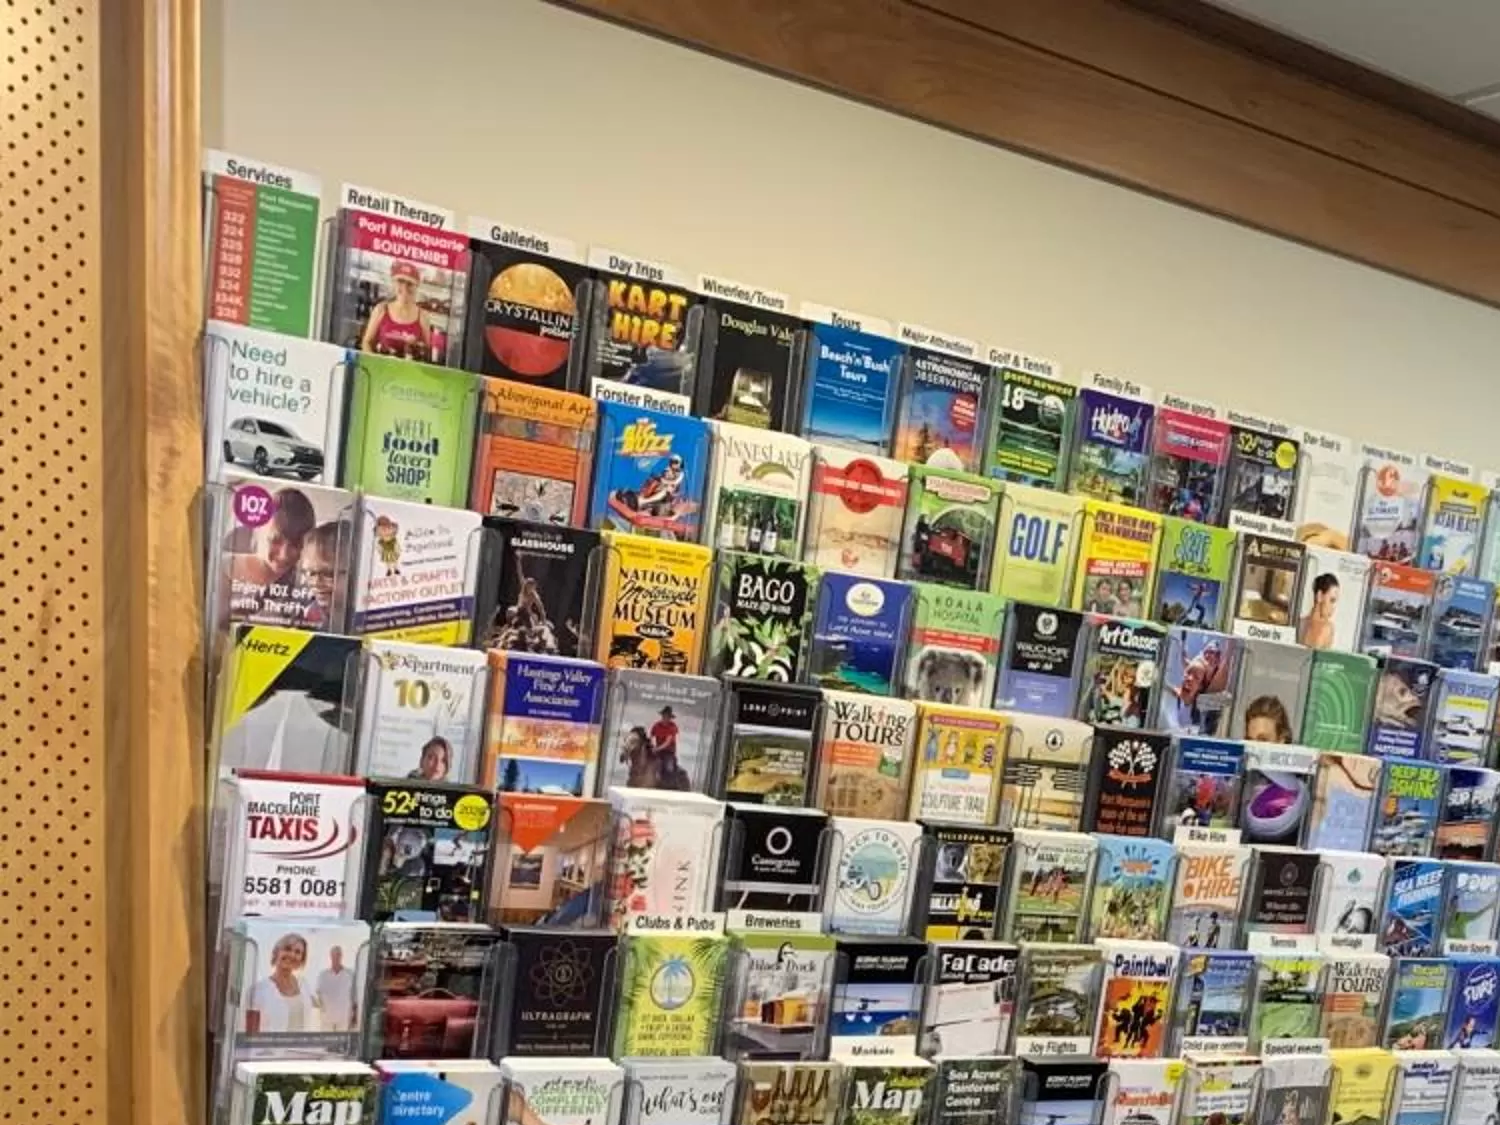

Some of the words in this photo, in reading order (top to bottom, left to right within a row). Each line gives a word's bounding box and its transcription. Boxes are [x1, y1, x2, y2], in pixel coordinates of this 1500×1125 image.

[226, 159, 293, 190] Services
[347, 189, 390, 212] Retail
[393, 201, 446, 229] Therapy
[359, 217, 385, 234] Port
[390, 225, 465, 251] Macquarie
[491, 226, 550, 253] Galleries
[372, 238, 449, 266] SOUVENIRS
[609, 256, 631, 273] Day
[634, 261, 664, 281] Trips
[608, 279, 688, 318] KART
[702, 278, 785, 310] Wineries/Tours
[611, 309, 678, 349] HIRE
[721, 313, 768, 338] Douglas
[831, 312, 862, 330] Tours
[902, 327, 927, 343] Major
[231, 340, 286, 364] Need
[990, 349, 1012, 363] Golf
[1013, 354, 1021, 366] &
[1023, 358, 1053, 374] Tennis
[229, 364, 249, 379] to
[255, 367, 293, 389] hire
[300, 377, 311, 391] a
[841, 366, 868, 384] Tours
[1093, 373, 1123, 391] Family
[1124, 381, 1141, 394] Fun
[228, 387, 311, 412] vehicle?
[498, 388, 564, 410] Aboriginal
[569, 403, 592, 416] Art
[595, 385, 640, 405] Forster
[643, 394, 686, 414] Region
[1002, 385, 1025, 409] 18
[381, 433, 439, 456] food
[388, 451, 431, 470] lovers
[386, 466, 431, 488] SHOP!
[241, 494, 268, 515] 10%
[511, 538, 575, 553] GLASSHOUSE
[1009, 512, 1068, 565] GOLF
[232, 581, 266, 597] Enjoy
[269, 583, 289, 597] 10%
[619, 567, 699, 588] NATIONAL
[738, 574, 796, 605] BAGO
[231, 598, 259, 610] with
[264, 601, 309, 616] Thrifty
[934, 596, 984, 612] KOALA
[613, 602, 696, 630] MUSEUM
[1099, 624, 1121, 643] Art
[245, 638, 290, 657] Hertz
[834, 701, 908, 726] Walking
[832, 721, 904, 746] TOURS
[248, 802, 320, 817] MACQUARIE
[289, 792, 320, 808] PORT
[420, 806, 433, 819] to
[435, 808, 452, 819] do
[248, 816, 319, 842] TAXIS
[1189, 829, 1207, 841] Bike
[1209, 831, 1226, 842] Hire
[1187, 854, 1234, 877] BIKE
[244, 878, 291, 895] 5581
[301, 879, 346, 897] 0081
[1196, 876, 1240, 900] HIRE
[636, 916, 670, 930] Clubs
[674, 916, 682, 929] &
[685, 916, 716, 932] Pubs
[745, 914, 801, 929] Breweries
[1114, 954, 1173, 978] Paintball
[1029, 1040, 1045, 1054] Joy
[1046, 1041, 1077, 1054] Flights
[1264, 1042, 1294, 1055] Special
[948, 1069, 970, 1081] Sea
[853, 1082, 922, 1116] Map
[947, 1082, 1000, 1095] Rainforest
[945, 1096, 981, 1108] Centre
